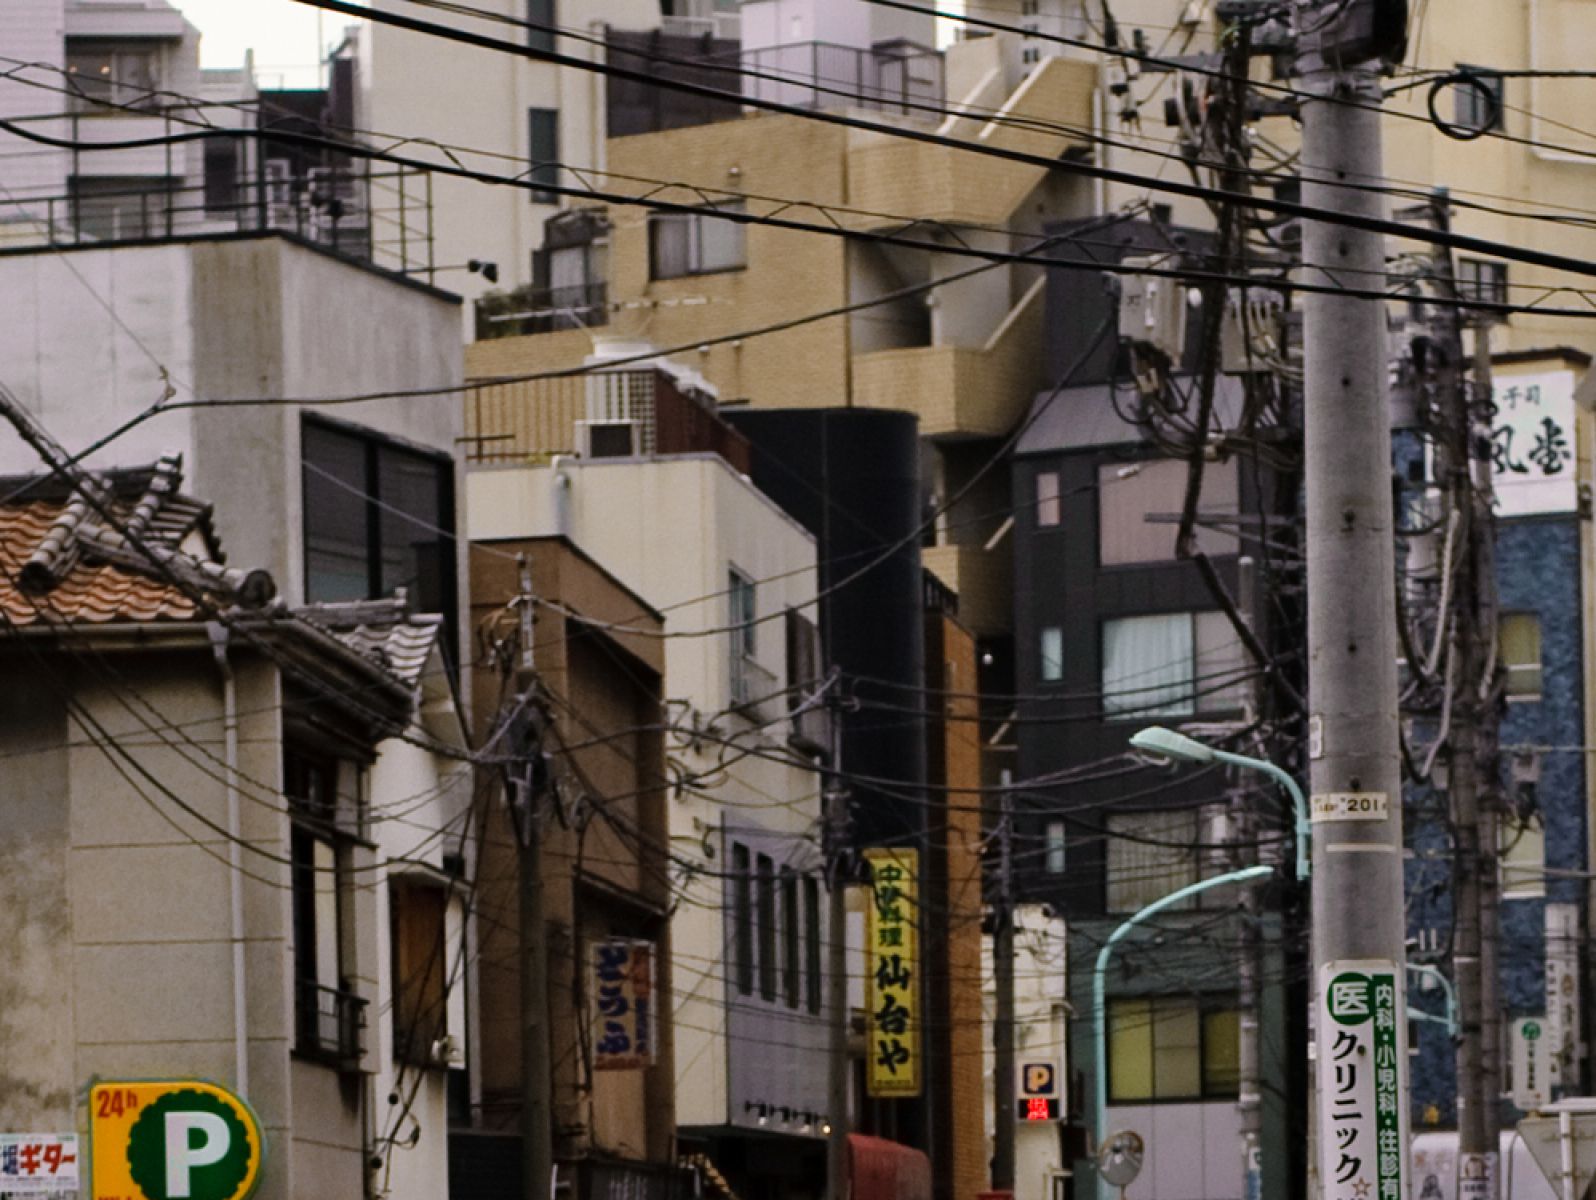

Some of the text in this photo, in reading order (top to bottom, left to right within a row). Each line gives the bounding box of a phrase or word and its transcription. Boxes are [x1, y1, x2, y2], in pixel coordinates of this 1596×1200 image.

[875, 953, 910, 1076] 仙台や
[1332, 981, 1369, 1016] 医
[164, 1110, 231, 1199] P
